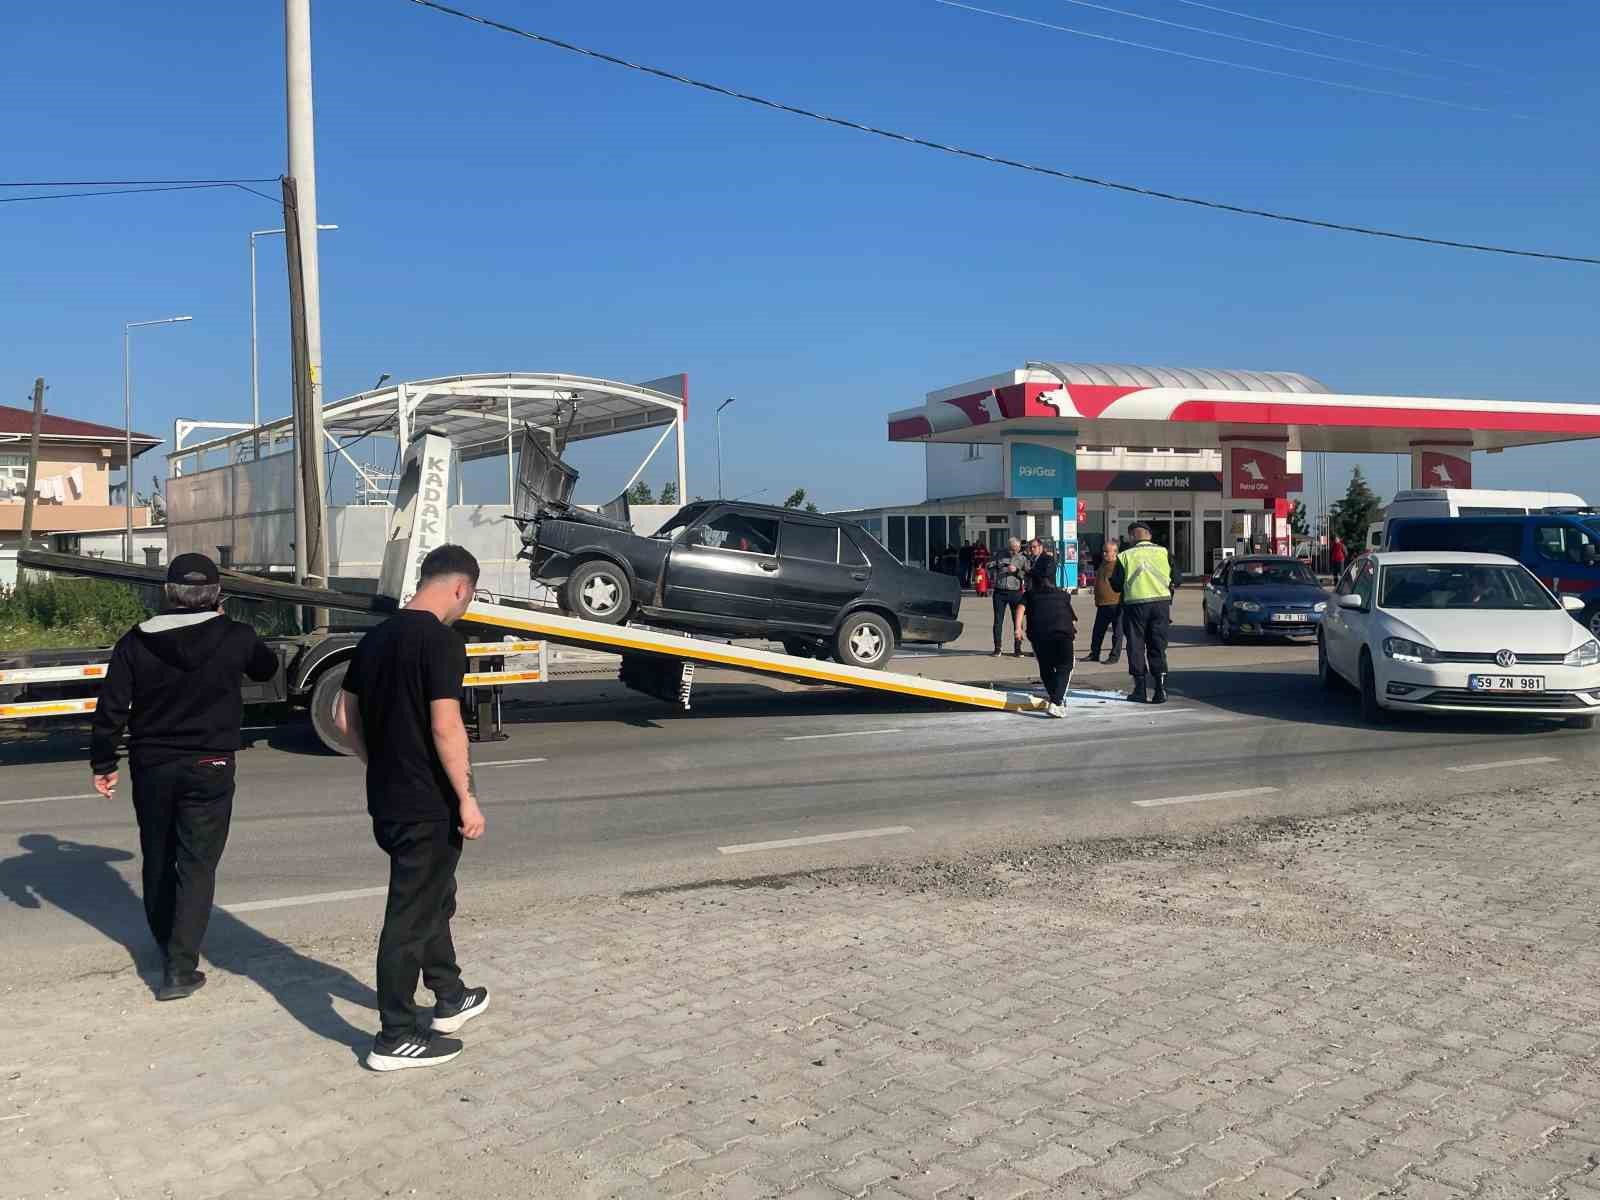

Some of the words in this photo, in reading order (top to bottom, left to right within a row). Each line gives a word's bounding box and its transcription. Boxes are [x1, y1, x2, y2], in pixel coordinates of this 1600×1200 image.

[1154, 475, 1190, 488] market
[1478, 677, 1492, 688] 59
[1500, 678, 1514, 688] ZN
[1520, 678, 1540, 689] 981
